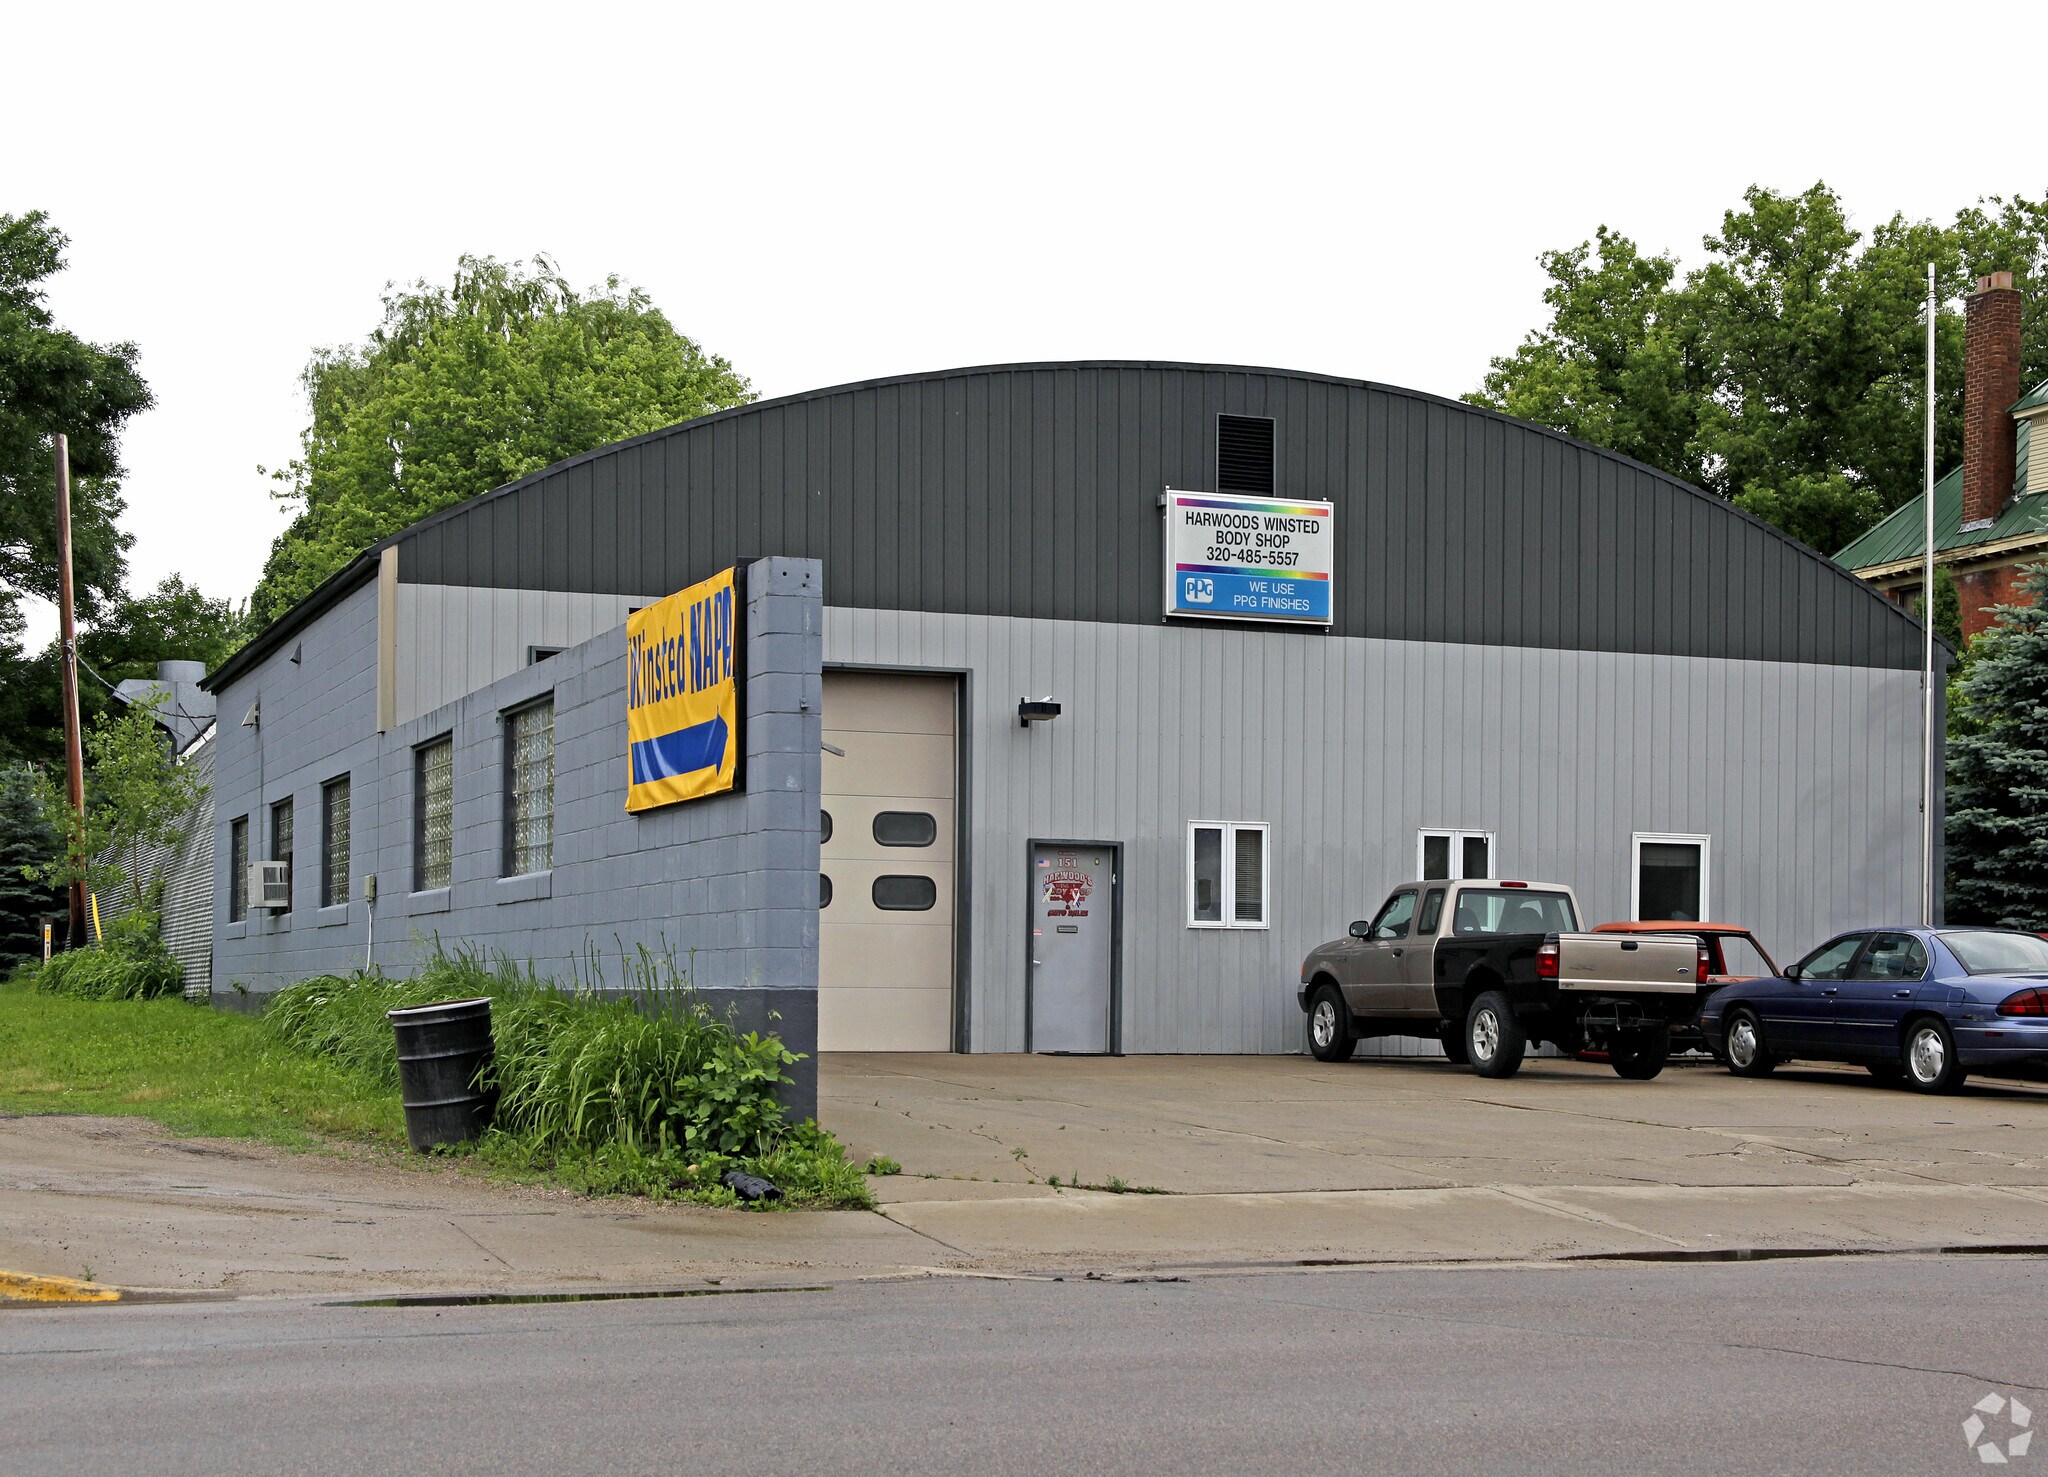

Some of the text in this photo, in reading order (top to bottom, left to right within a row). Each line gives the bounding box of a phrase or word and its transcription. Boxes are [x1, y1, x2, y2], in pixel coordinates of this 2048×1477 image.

[1185, 511, 1320, 534] HARWOODS WINSTED
[1216, 531, 1290, 548] BODY SHOP
[1206, 547, 1299, 566] 320-485-5557
[1249, 581, 1295, 595] WE USE
[1233, 595, 1310, 611] PPG FINISHES
[629, 586, 732, 710] Winsted NAPA
[1058, 858, 1078, 868] 151
